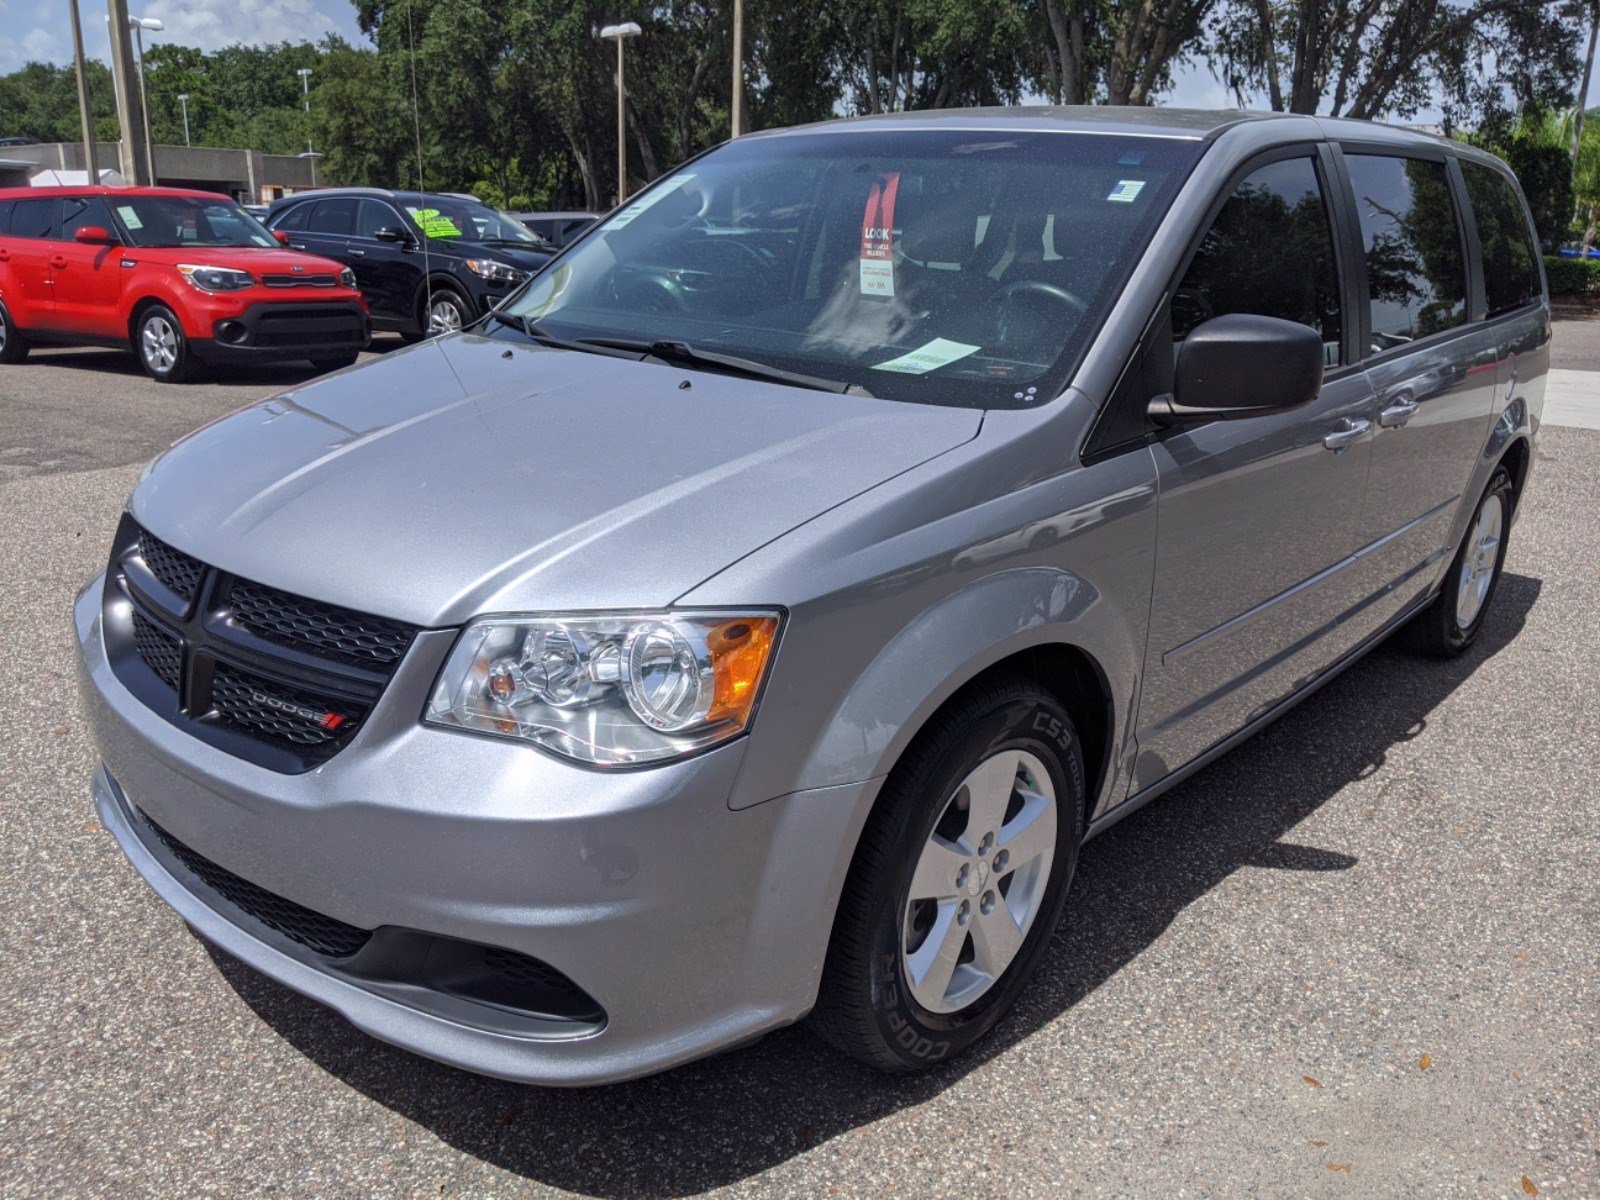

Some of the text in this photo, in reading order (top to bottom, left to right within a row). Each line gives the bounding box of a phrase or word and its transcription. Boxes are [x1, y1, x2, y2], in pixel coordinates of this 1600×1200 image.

[864, 227, 890, 240] LOOK
[252, 691, 329, 722] DODGE
[1032, 711, 1072, 750] CS3
[880, 952, 951, 1060] COOPER
